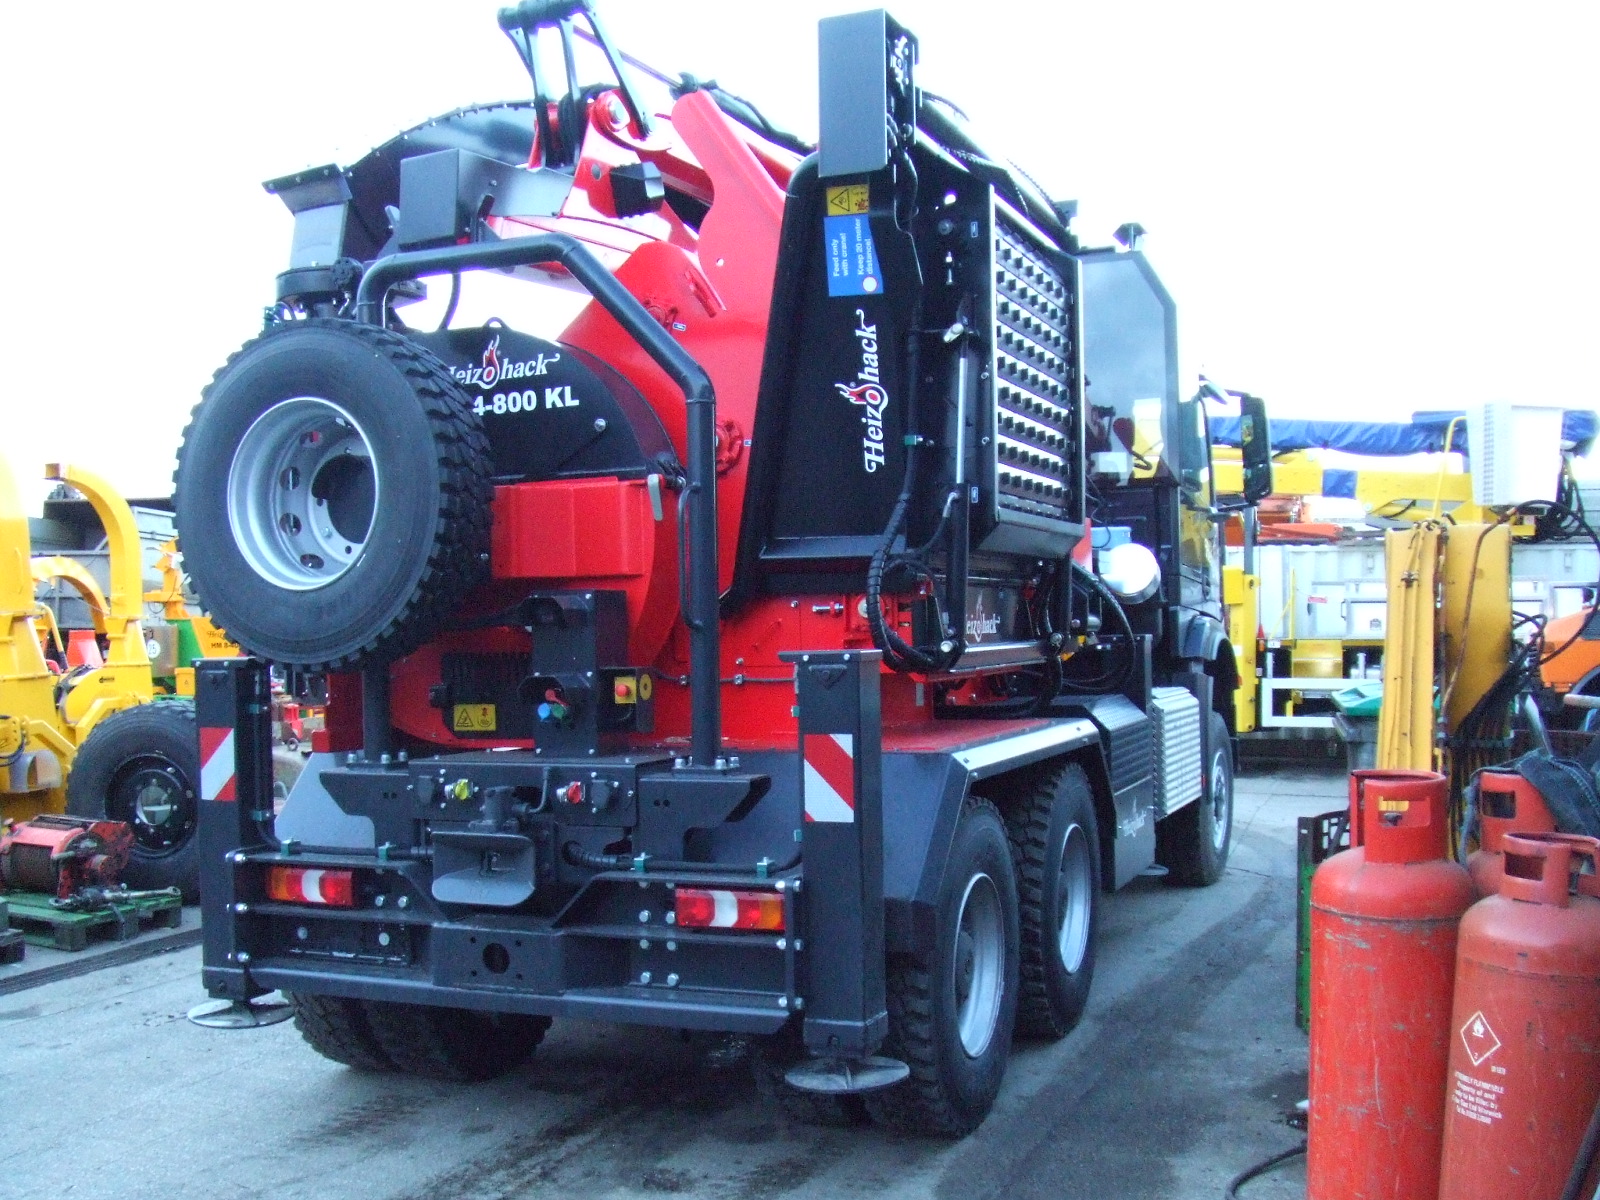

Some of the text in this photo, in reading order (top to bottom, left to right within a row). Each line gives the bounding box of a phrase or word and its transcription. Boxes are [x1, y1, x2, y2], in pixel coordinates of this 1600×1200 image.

[831, 239, 840, 277] Feed only
[855, 243, 863, 253] 20
[841, 258, 849, 276] with
[857, 254, 865, 275] Keep
[545, 386, 579, 409] KL
